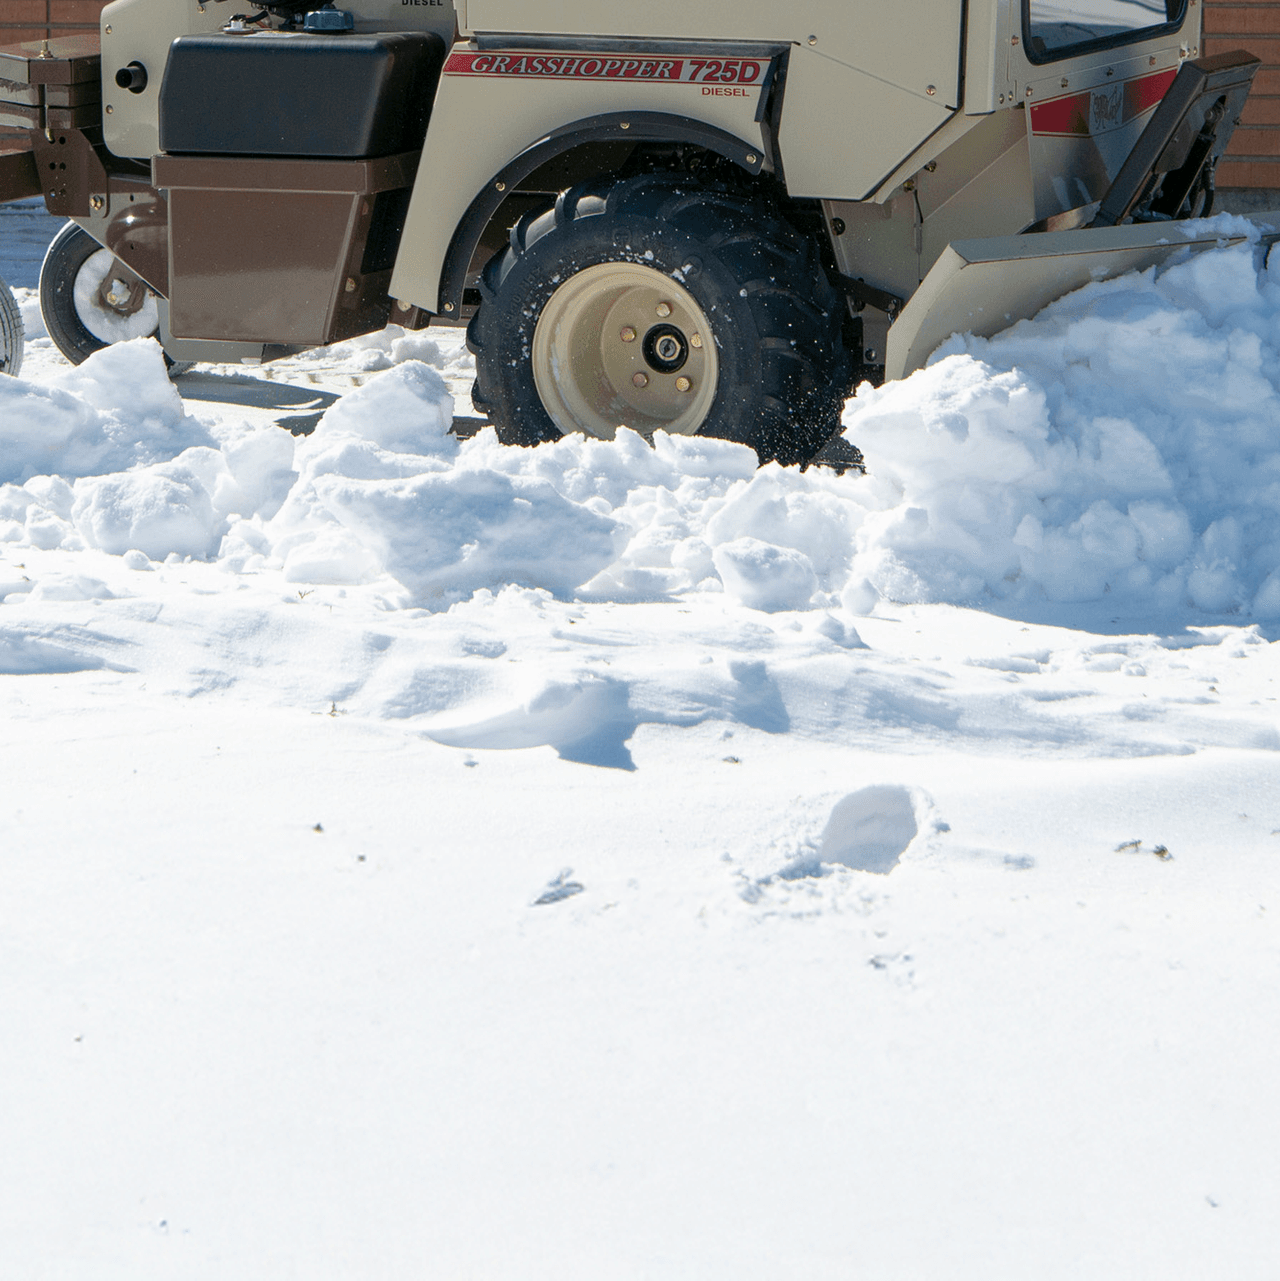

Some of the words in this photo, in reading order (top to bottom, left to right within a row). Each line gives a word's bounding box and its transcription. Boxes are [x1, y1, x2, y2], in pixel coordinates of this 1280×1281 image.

[470, 55, 674, 79] GRASSHOPPER
[688, 60, 761, 83] 725D
[701, 87, 751, 98] DIESEL
